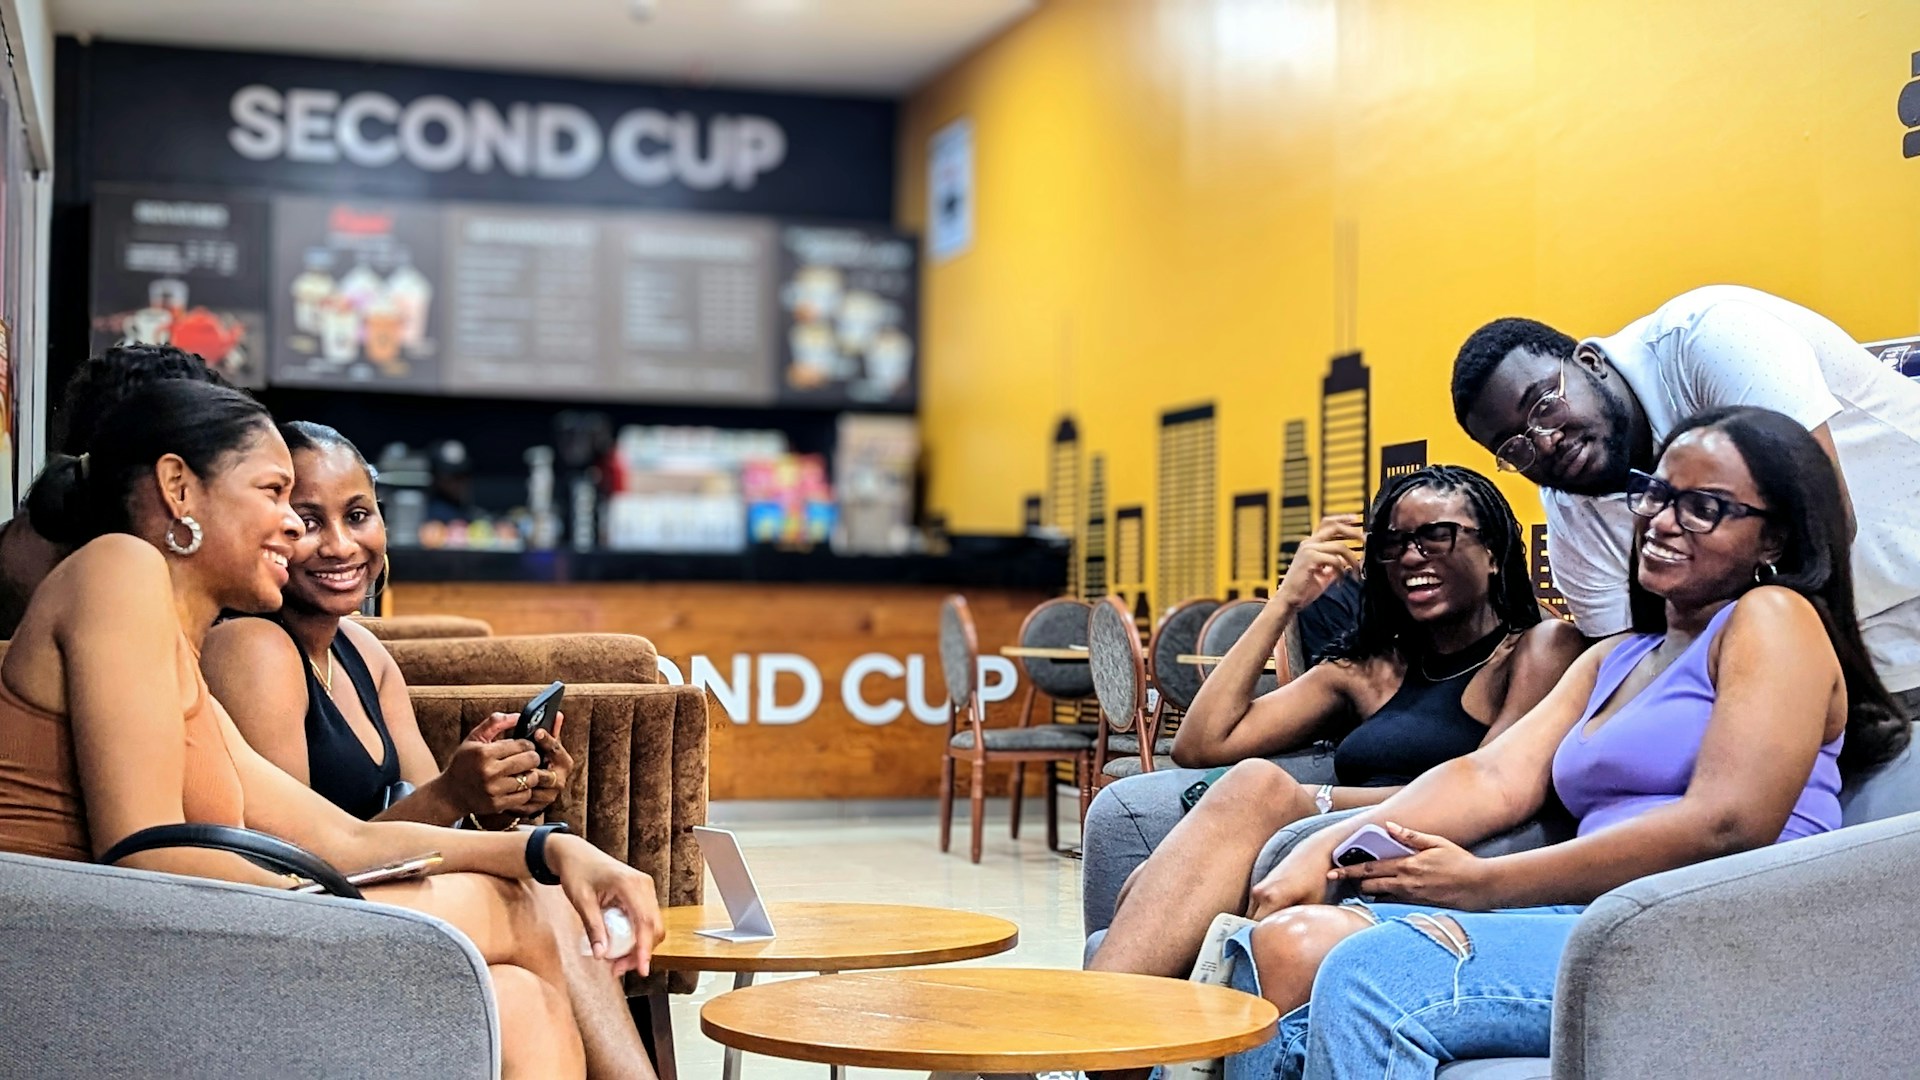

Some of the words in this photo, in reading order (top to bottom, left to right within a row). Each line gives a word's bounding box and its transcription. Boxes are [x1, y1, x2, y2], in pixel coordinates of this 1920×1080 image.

[228, 84, 602, 180] SECOND
[608, 108, 787, 191] CUP
[657, 653, 823, 725] ND
[841, 652, 1019, 725] CUP
